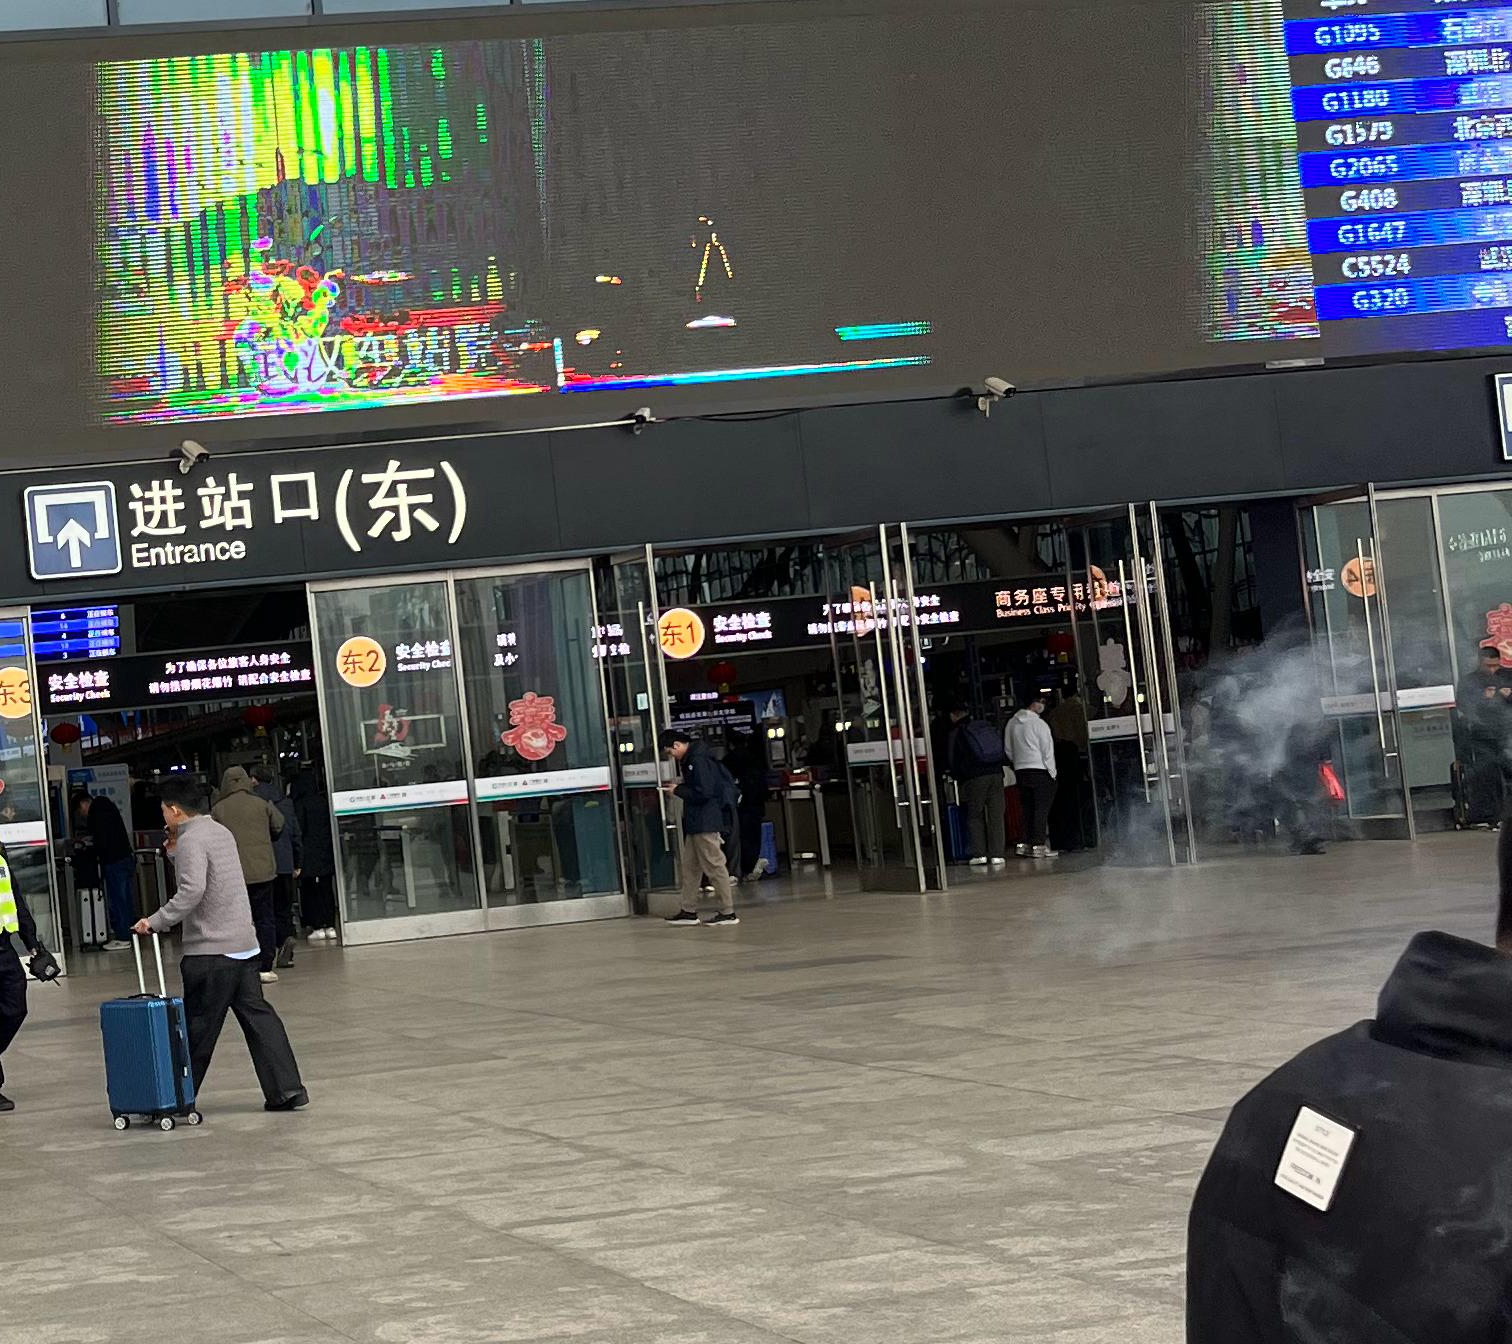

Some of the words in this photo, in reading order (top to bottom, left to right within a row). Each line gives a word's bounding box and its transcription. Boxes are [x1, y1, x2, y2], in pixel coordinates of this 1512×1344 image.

[1341, 253, 1412, 279] C5524
[131, 540, 246, 568] Entrance
[713, 611, 772, 633] 安全检查
[996, 607, 1031, 618] Business
[1033, 605, 1055, 615] Class
[661, 620, 696, 647] 东1
[342, 649, 382, 676] 东2
[48, 669, 110, 692] 安全检查
